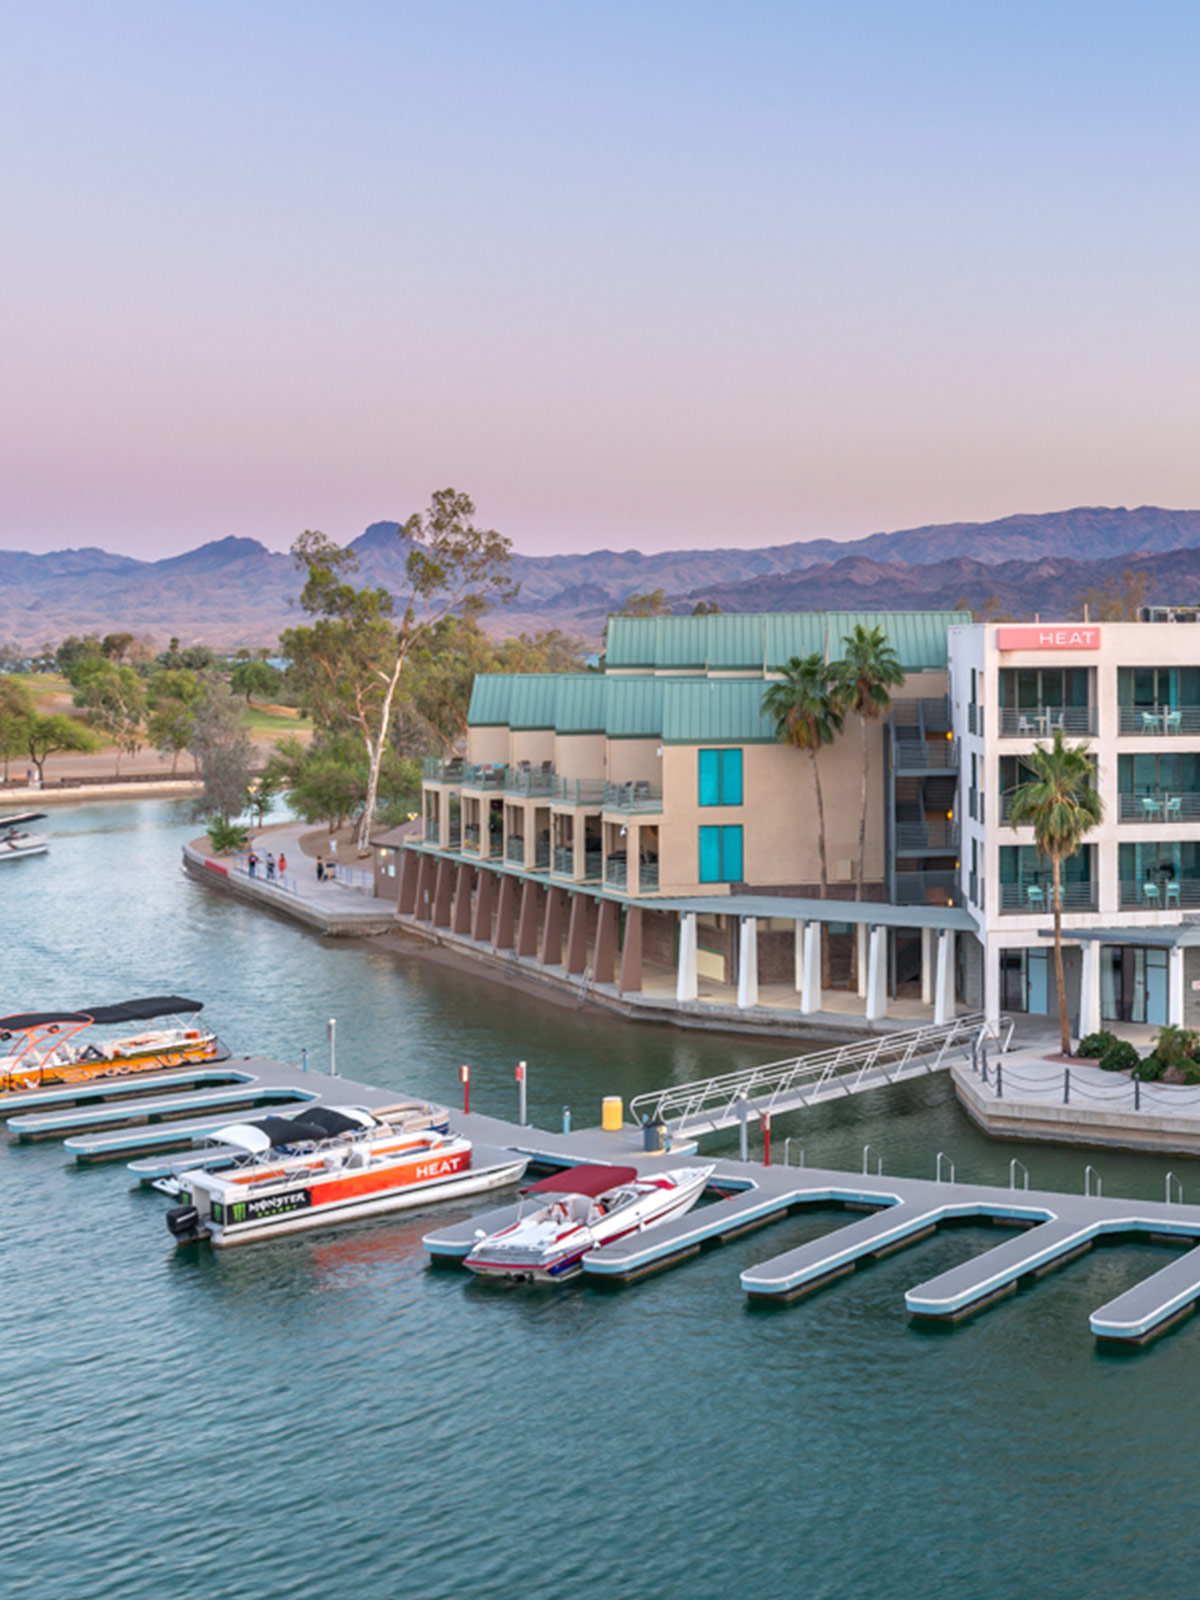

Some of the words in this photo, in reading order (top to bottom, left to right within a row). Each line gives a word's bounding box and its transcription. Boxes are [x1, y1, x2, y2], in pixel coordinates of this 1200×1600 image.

[1039, 631, 1095, 645] HEAT
[416, 1158, 461, 1179] HEAT
[248, 1191, 306, 1213] MONSTER
